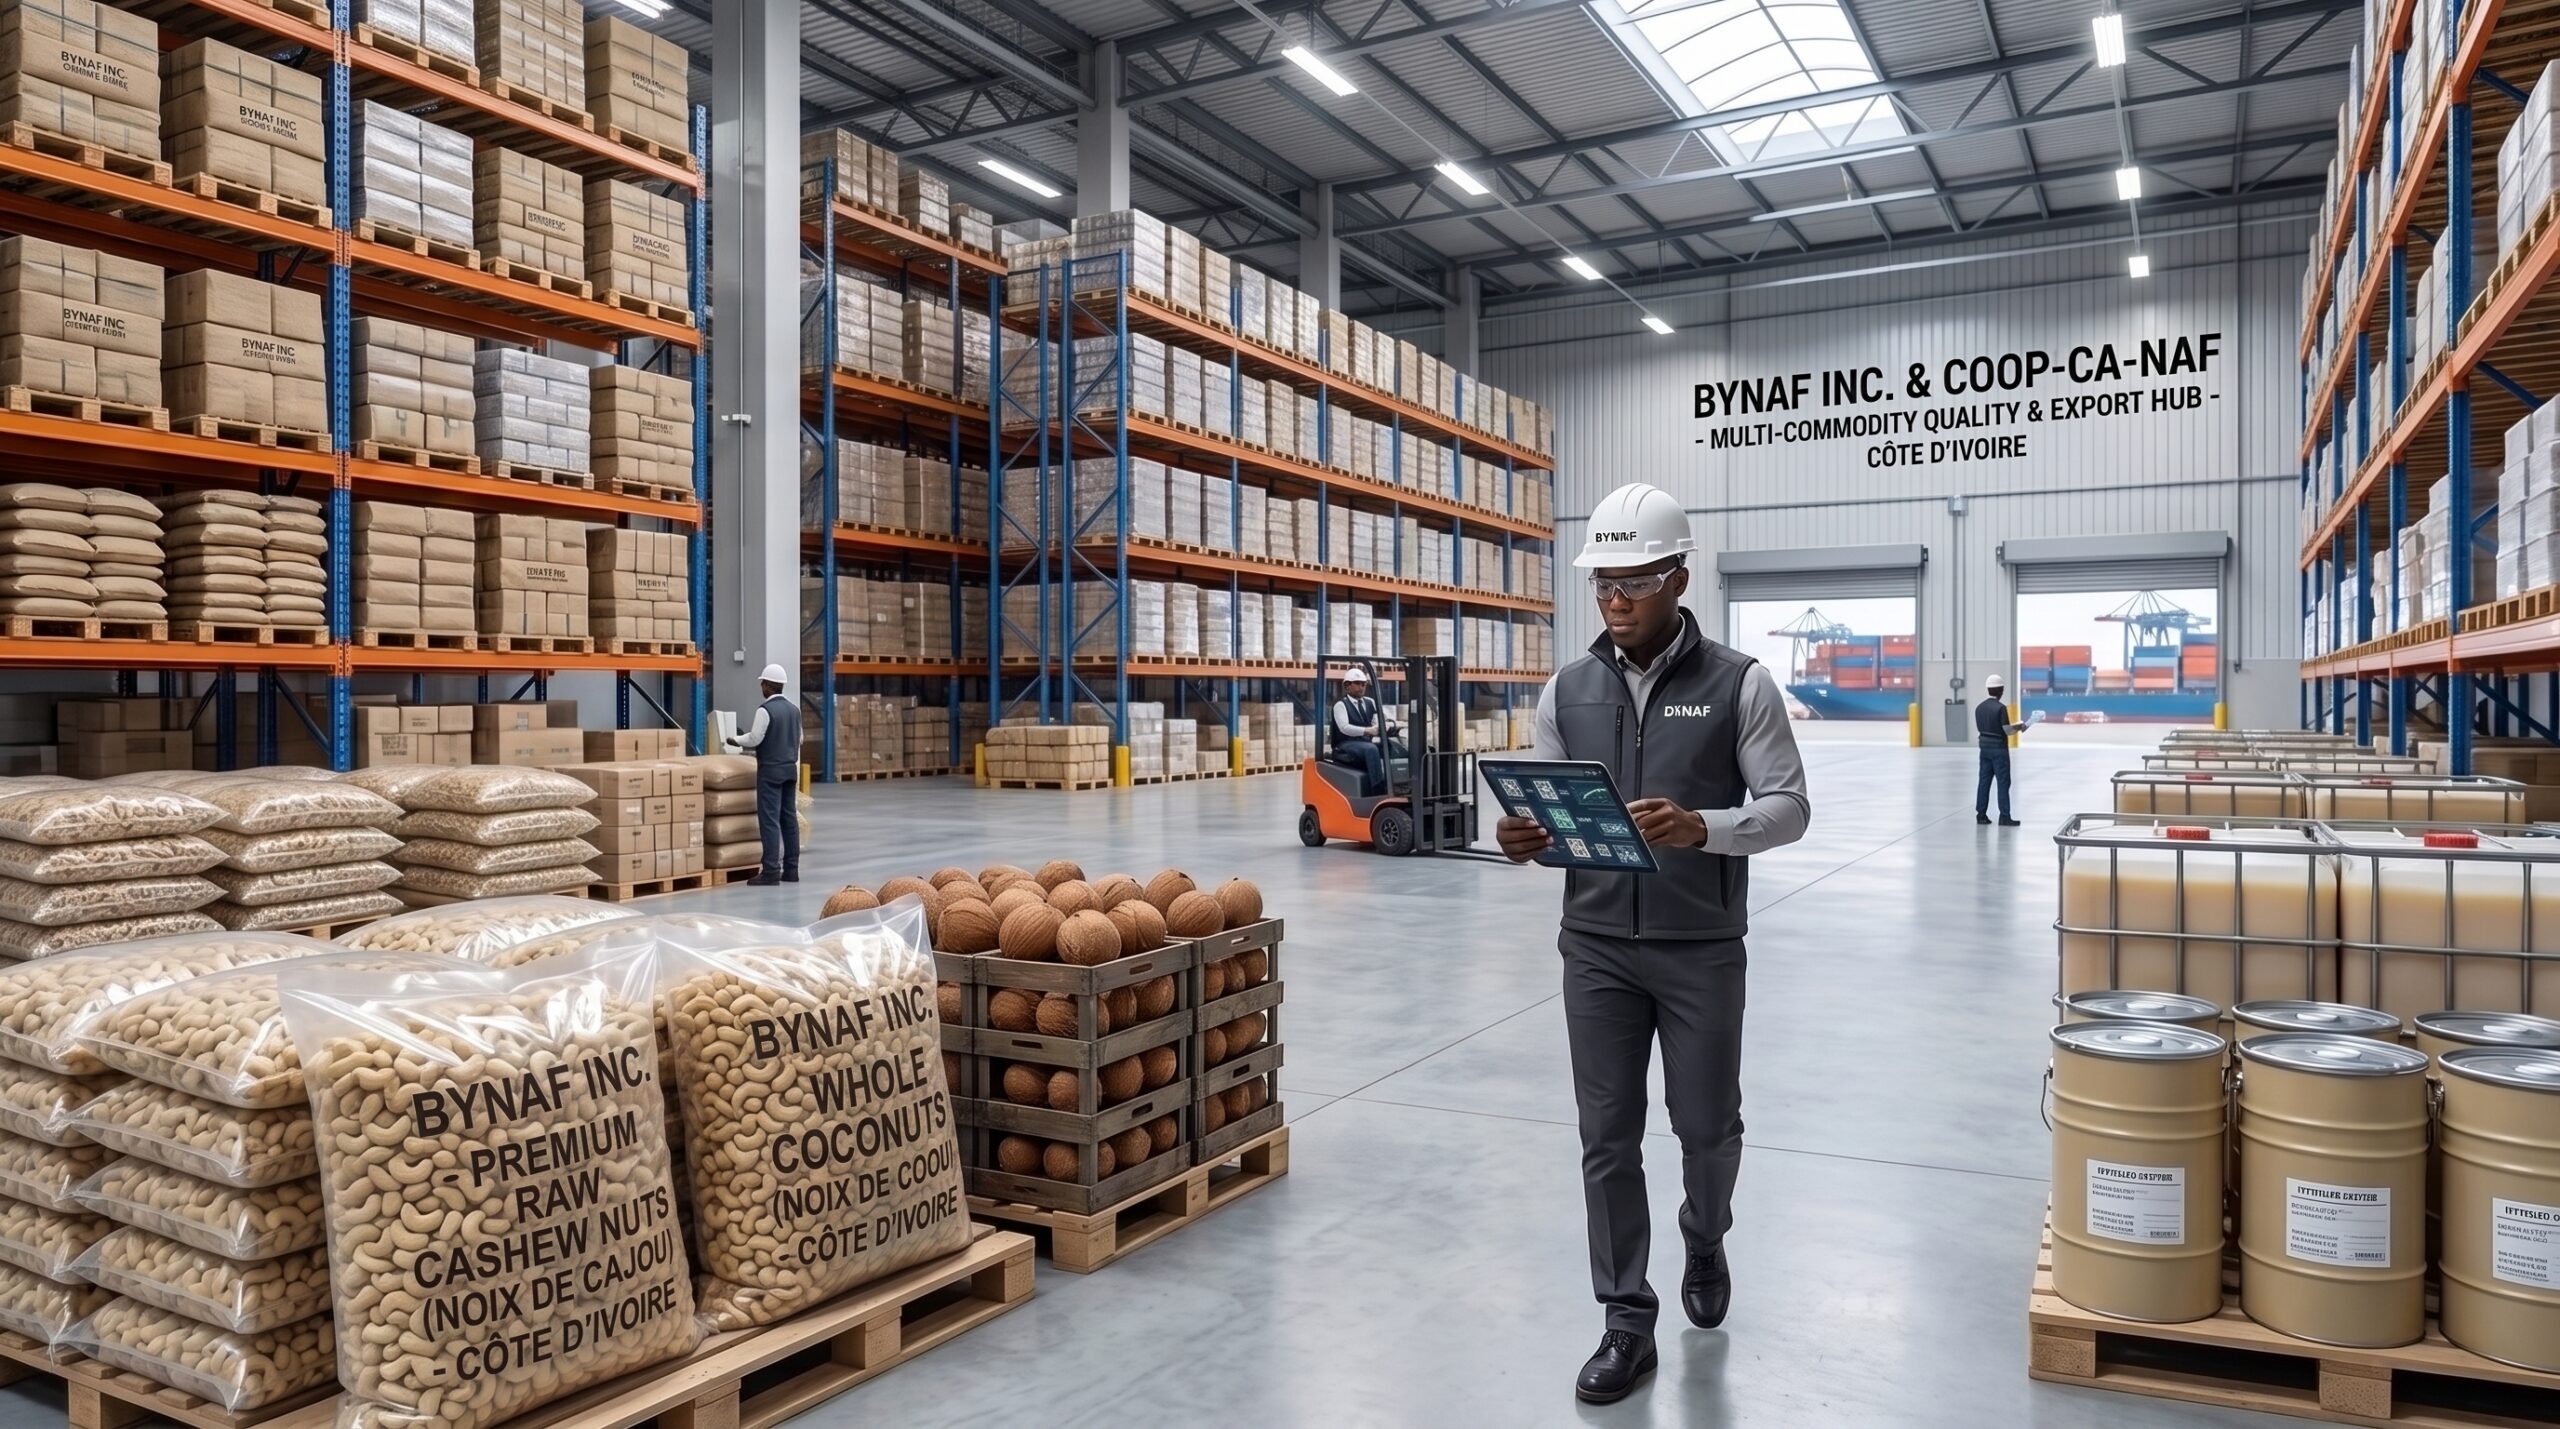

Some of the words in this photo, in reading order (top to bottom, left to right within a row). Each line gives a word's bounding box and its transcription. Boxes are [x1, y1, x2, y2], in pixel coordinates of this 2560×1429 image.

[61, 51, 102, 71] BYNAF
[63, 308, 102, 325] BYNAF
[104, 316, 125, 330] INC
[241, 338, 275, 352] BYNAF
[276, 344, 295, 357] INC
[1694, 373, 1811, 419] BYNAF
[1822, 366, 1894, 407] INC.
[1906, 362, 1931, 399] &
[1943, 333, 2221, 395] COOP-CA-NAF
[1711, 410, 1918, 449] MULTI-COMMODITY
[1924, 401, 2020, 434] QUALITY
[2027, 400, 2043, 422] &
[2051, 390, 2144, 421] EXPORT
[2151, 385, 2202, 412] HUB
[1867, 440, 1924, 468] CÔTE
[1930, 435, 2027, 464] D'IVOIRE
[750, 999, 874, 1060] BYNAF
[881, 985, 933, 1032] INC.
[412, 1064, 571, 1138] BYNAF
[582, 1046, 651, 1100] INC.
[809, 1046, 928, 1115] WHOLE
[470, 1111, 638, 1187] PREMIUM
[772, 1090, 946, 1174] COCONUTS
[515, 1167, 600, 1224] RAW
[773, 1178, 852, 1229] (NOIX
[858, 1167, 891, 1204] DE
[798, 1223, 868, 1265] CÔTE
[875, 1185, 958, 1247] D'IVOIRE
[414, 1216, 589, 1289] CASHEW
[599, 1186, 669, 1245] NUTS
[423, 1283, 523, 1342] (NOIX
[532, 1269, 575, 1311] DE
[583, 1228, 674, 1294] CAJOU)
[456, 1332, 552, 1381] CÔTE
[563, 1278, 677, 1354] D'IVOIRE
